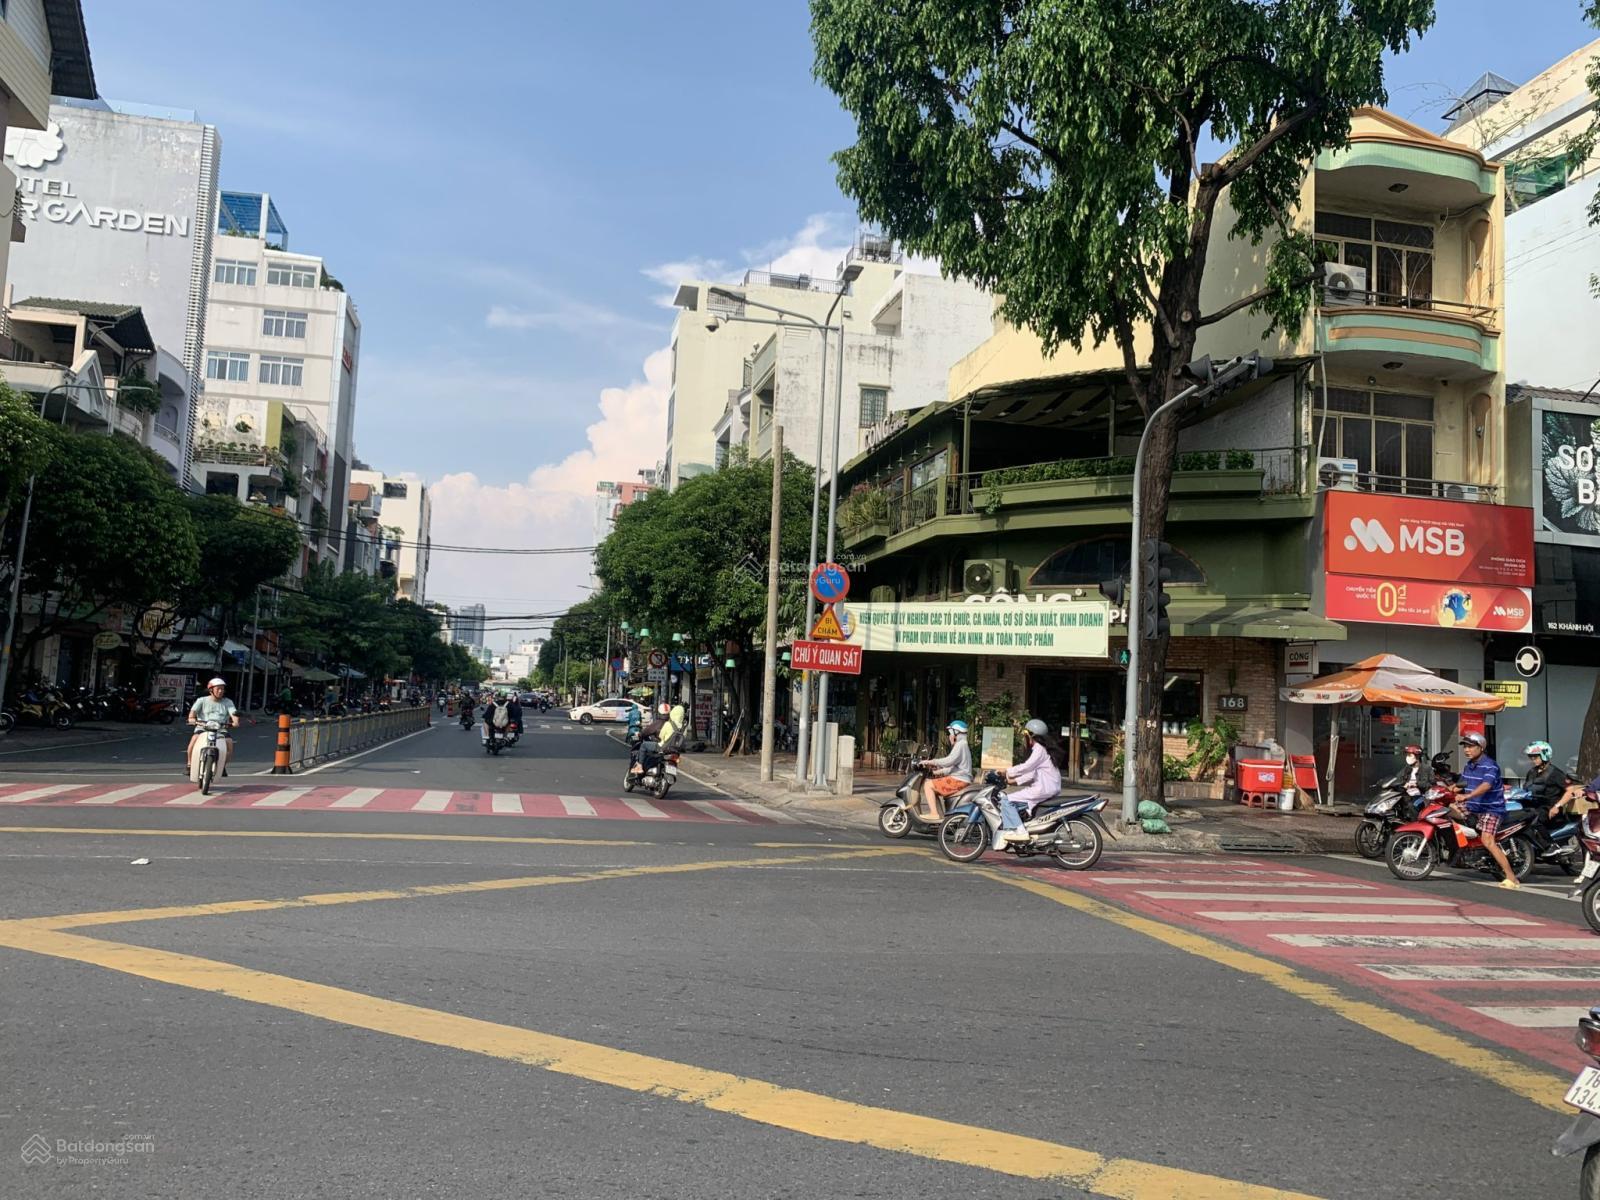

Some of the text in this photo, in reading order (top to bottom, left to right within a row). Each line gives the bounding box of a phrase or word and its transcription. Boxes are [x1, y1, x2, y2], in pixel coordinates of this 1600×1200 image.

[43, 200, 189, 237] GARDEN
[1578, 479, 1600, 505] B
[1400, 525, 1465, 556] MSB
[872, 609, 890, 626] QUYẾT
[906, 609, 929, 626] NGHIÊM
[930, 609, 942, 626] CÁC
[1060, 612, 1077, 627] KINH
[1079, 612, 1103, 627] DOANH
[1507, 607, 1524, 617] MSB
[1558, 621, 1582, 631] KHÁNH
[920, 631, 932, 645] QUY
[958, 631, 967, 645] AN
[985, 632, 995, 646] AN
[996, 630, 1012, 646] TOÀN
[1015, 631, 1032, 648] THỰC
[794, 644, 859, 667] CHÚ Ý QUAN SÁT
[1417, 687, 1455, 695] MSB
[1222, 696, 1245, 708] 168
[1146, 720, 1157, 729] 54
[1570, 1086, 1600, 1110] 134.
